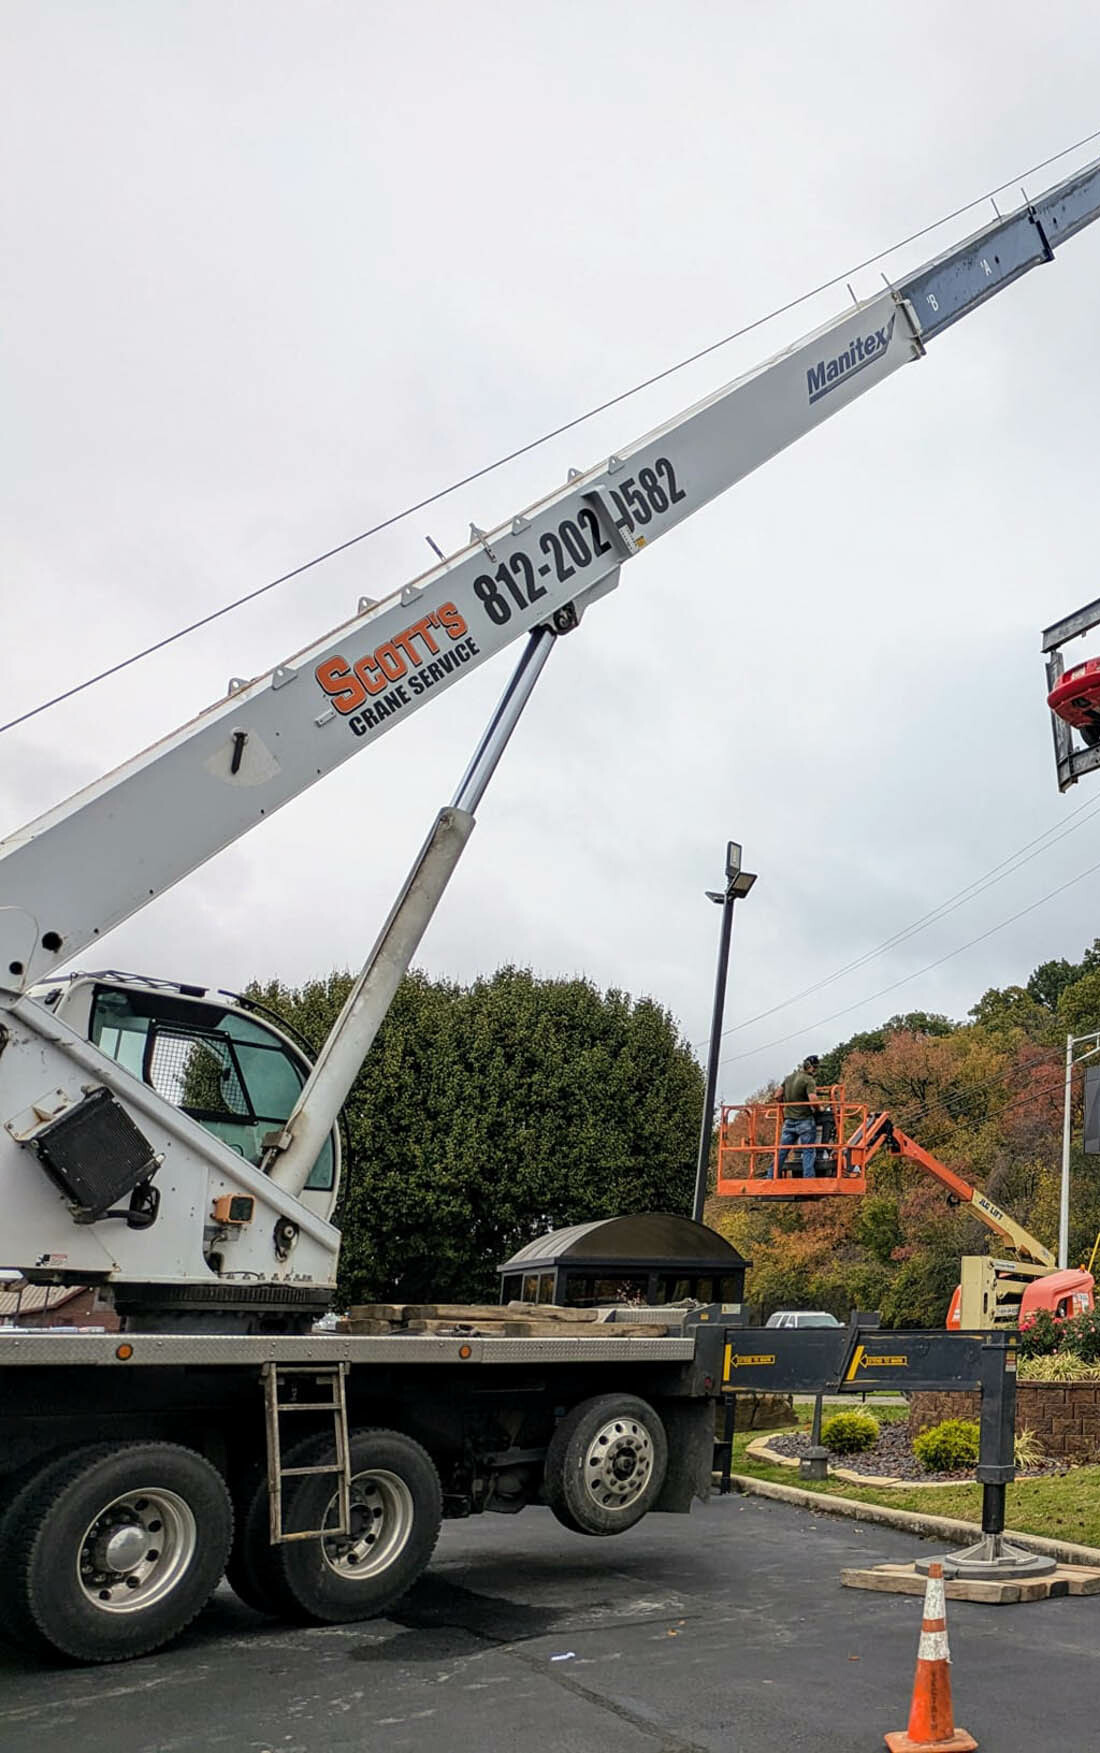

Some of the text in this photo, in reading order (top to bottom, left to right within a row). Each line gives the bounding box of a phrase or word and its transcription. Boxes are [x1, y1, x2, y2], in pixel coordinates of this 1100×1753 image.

[807, 327, 887, 395] Manitex
[349, 636, 481, 737] CRANE SERVICE
